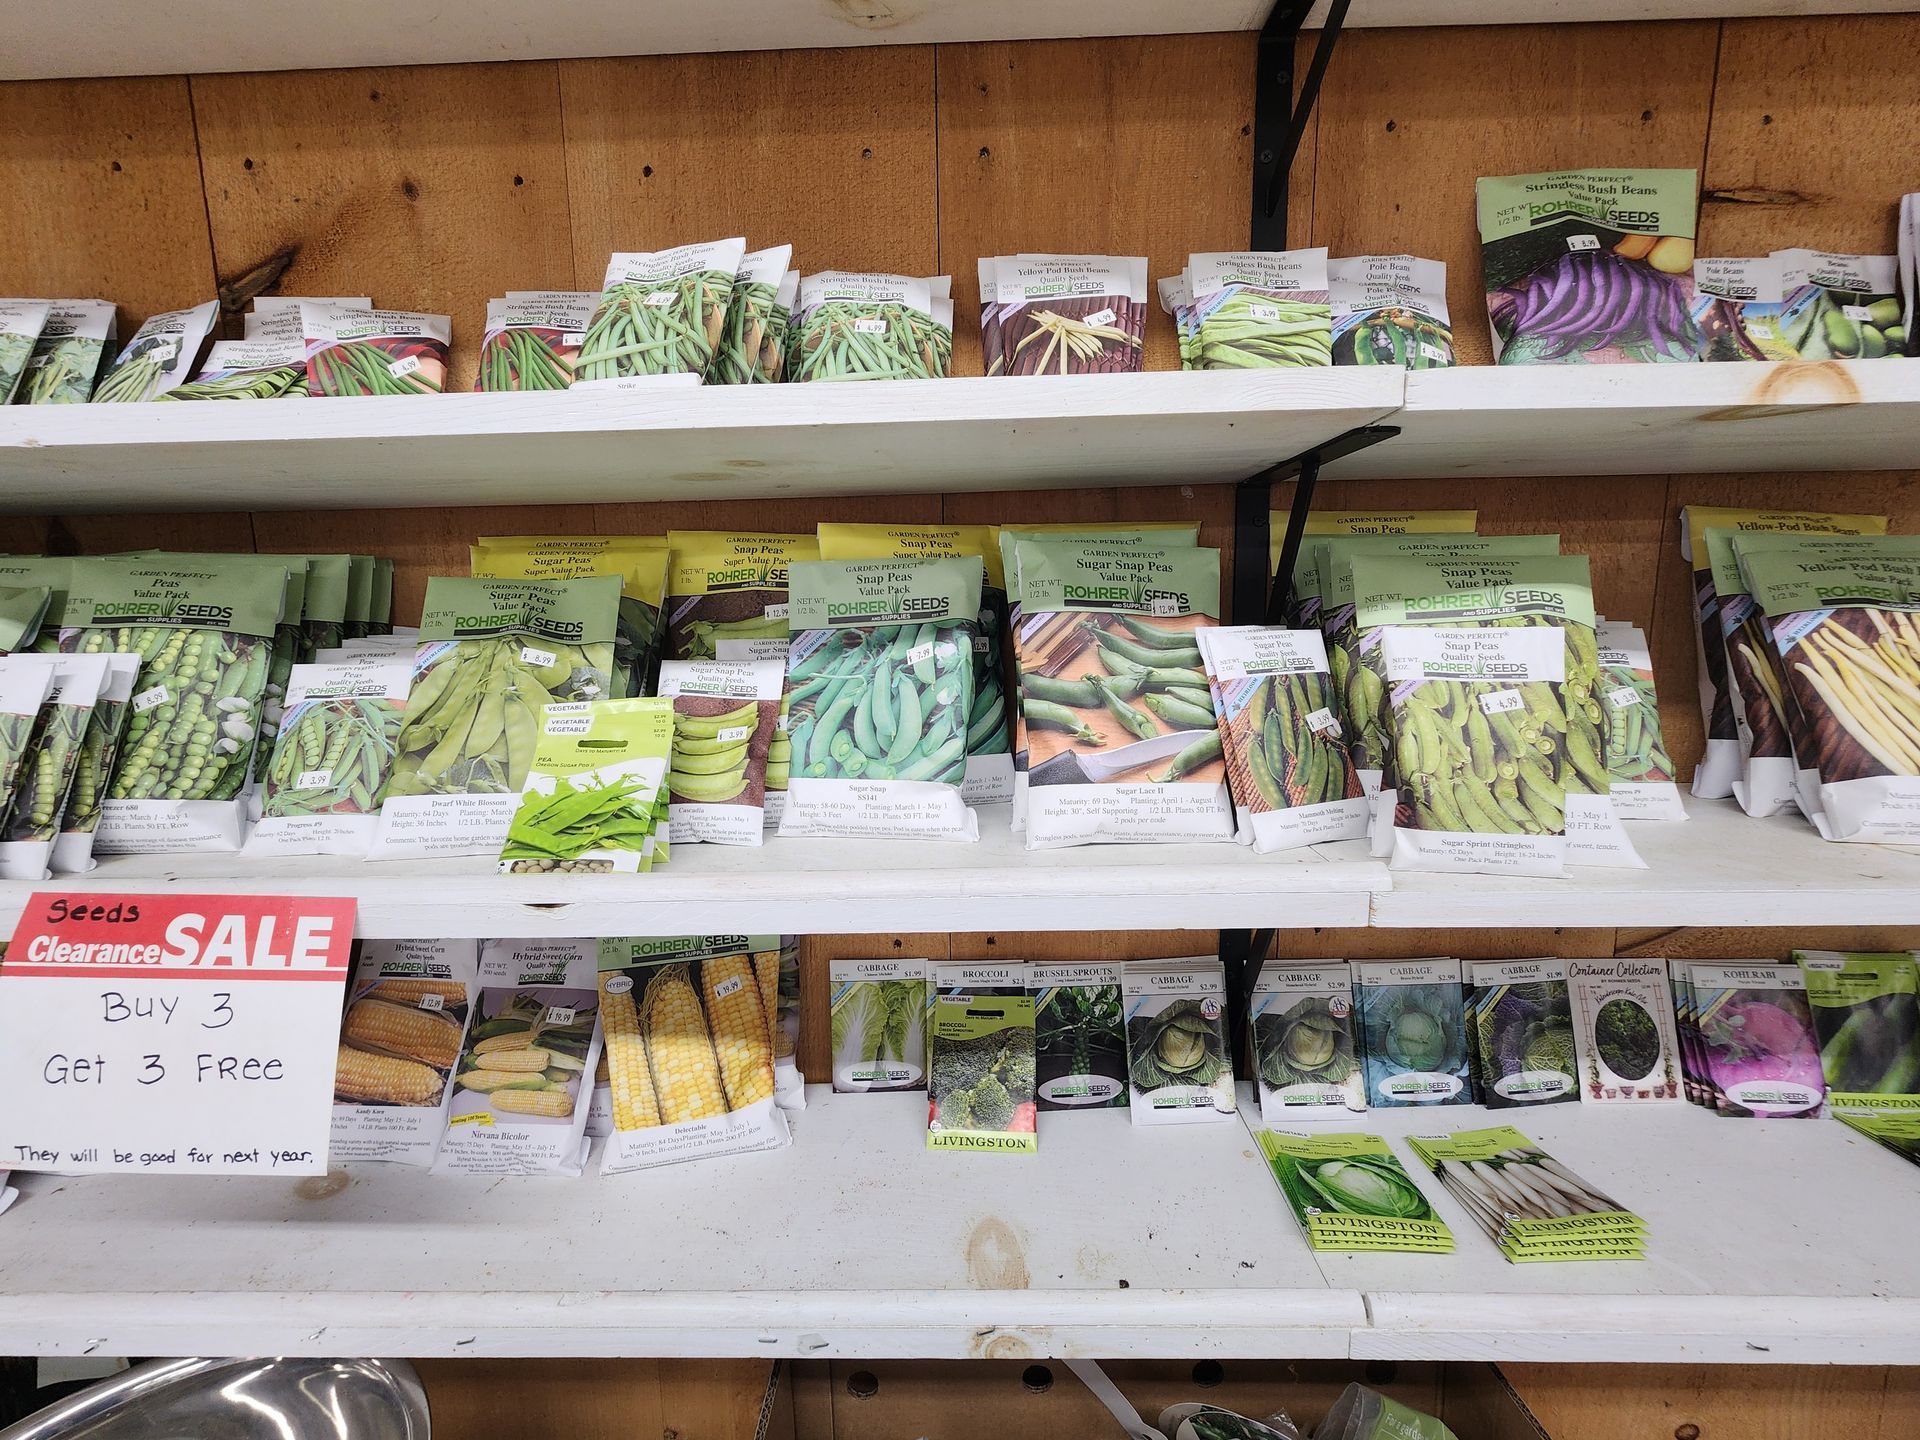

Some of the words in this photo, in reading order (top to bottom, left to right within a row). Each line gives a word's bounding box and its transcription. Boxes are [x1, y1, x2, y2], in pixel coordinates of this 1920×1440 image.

[1526, 184, 1584, 192] Stringless
[1588, 185, 1616, 194] Bush
[1622, 186, 1657, 195] Beans
[1568, 191, 1592, 202] Value
[1595, 197, 1618, 206] Pack
[1530, 201, 1594, 217] ROHRER
[1609, 211, 1659, 222] SEEDS
[677, 260, 706, 272] SEEDS
[1216, 261, 1255, 269] Stringless
[1018, 268, 1043, 276] Yellow
[1222, 275, 1260, 283] ROHRER
[1025, 284, 1065, 294] ROHRER
[1074, 281, 1104, 290] SEEDS
[824, 290, 865, 299] ROHRER
[506, 316, 544, 324] ROHRER
[552, 318, 583, 326] SEEDS
[336, 327, 379, 336] ROHRER
[1350, 525, 1372, 534] Snap
[1375, 524, 1405, 534] Peas
[900, 540, 927, 548] Snap
[930, 540, 952, 548] Peas
[734, 546, 757, 555] Snap
[762, 545, 784, 554] Peas
[533, 557, 564, 566] Sugar
[1076, 558, 1112, 571] Sugar
[1116, 561, 1145, 570] Snap
[1148, 562, 1173, 572] Peas
[708, 570, 755, 583] ROHRER
[1442, 567, 1476, 578] Snap
[1480, 567, 1512, 576] Peas
[856, 575, 884, 584] Snap
[888, 574, 913, 583] Peas
[1100, 573, 1127, 582] Value
[1131, 574, 1153, 583] Pack
[152, 579, 180, 588] Peas
[1446, 579, 1480, 589] Value
[1484, 578, 1514, 587] Pack
[133, 590, 161, 598] Value
[165, 590, 190, 599] Pack
[859, 587, 885, 595] Value
[887, 586, 910, 595] Pack
[1064, 584, 1129, 600] ROHRER
[1145, 589, 1188, 604] SEEDS
[1815, 586, 1893, 599] ROHRER
[489, 591, 524, 601] Sugar
[528, 593, 556, 606] Peas
[1405, 594, 1483, 610] ROHRER
[1504, 591, 1563, 605] SEEDS
[94, 603, 159, 615] ROHRER
[176, 605, 233, 618] SEEDS
[522, 603, 547, 614] Pack
[828, 601, 887, 616] ROHRER
[903, 597, 949, 610] SEEDS
[1159, 605, 1175, 614] 12.99
[773, 609, 788, 617] 12.99
[455, 613, 517, 627] ROHRER
[534, 618, 583, 633] SEEDS
[1254, 642, 1274, 650] Sugar
[1445, 641, 1470, 652] Snap
[1473, 641, 1498, 650] Peas
[535, 655, 551, 664] 8.99
[1441, 652, 1473, 662] Quality
[1478, 652, 1505, 661] Seeds
[1243, 659, 1279, 668] ROHRER
[1423, 662, 1472, 672] ROHRER
[1486, 663, 1527, 672] SEEDS
[305, 687, 346, 695] ROHRER
[680, 682, 719, 692] ROHRER
[729, 685, 757, 693] SEEDS
[1498, 697, 1518, 709] 4.99
[1116, 788, 1135, 796] Sugar
[1102, 807, 1138, 815] Supporting
[1584, 812, 1600, 820] May
[1442, 840, 1464, 848] Sugar
[1466, 840, 1490, 848] Sprint
[1492, 841, 1535, 849] (Stringless)
[47, 899, 139, 923] Seeds
[28, 936, 161, 964] Clearance
[160, 912, 334, 969] SALE
[632, 940, 690, 956] ROHRER
[706, 935, 749, 949] SEEDS
[381, 963, 422, 971] ROHRER
[428, 965, 451, 973] SEEDS
[857, 964, 899, 972] CABBAGE
[1033, 969, 1071, 978] BRUSSEL
[1074, 967, 1112, 976] SPROUTS
[1390, 967, 1432, 975] CABBAGE
[1501, 965, 1541, 975] CABBAGE
[1569, 962, 1614, 977] Container
[1617, 962, 1662, 977] Collection
[962, 970, 1009, 978] BROCCOLI
[1278, 974, 1321, 982] CABBAGE
[1546, 971, 1562, 979] $1.99
[1724, 970, 1776, 980] KOHLRABI
[1151, 975, 1194, 984] CABBAGE
[607, 980, 633, 990] HYBRID
[1200, 983, 1217, 991] $2.99
[201, 993, 233, 1028] 3
[556, 1013, 571, 1023] 19.99
[44, 1055, 105, 1084] Get
[137, 1055, 165, 1085] 3
[1153, 1097, 1183, 1105] ROHRER
[1191, 1096, 1214, 1104] SEEDS
[675, 1125, 706, 1134] Delectable
[472, 1131, 499, 1140] Nirvana
[502, 1132, 529, 1141] Bicolor
[933, 1135, 1027, 1149] LIVINGSTON
[14, 1146, 59, 1163] They
[70, 1149, 97, 1162] will
[114, 1149, 133, 1163] be
[141, 1150, 175, 1165] good
[188, 1148, 213, 1163] for
[224, 1148, 258, 1162] next
[271, 1149, 314, 1168] year.
[1316, 1216, 1438, 1234] LIVINGSTON
[1522, 1216, 1633, 1232] LIVINGSTON
